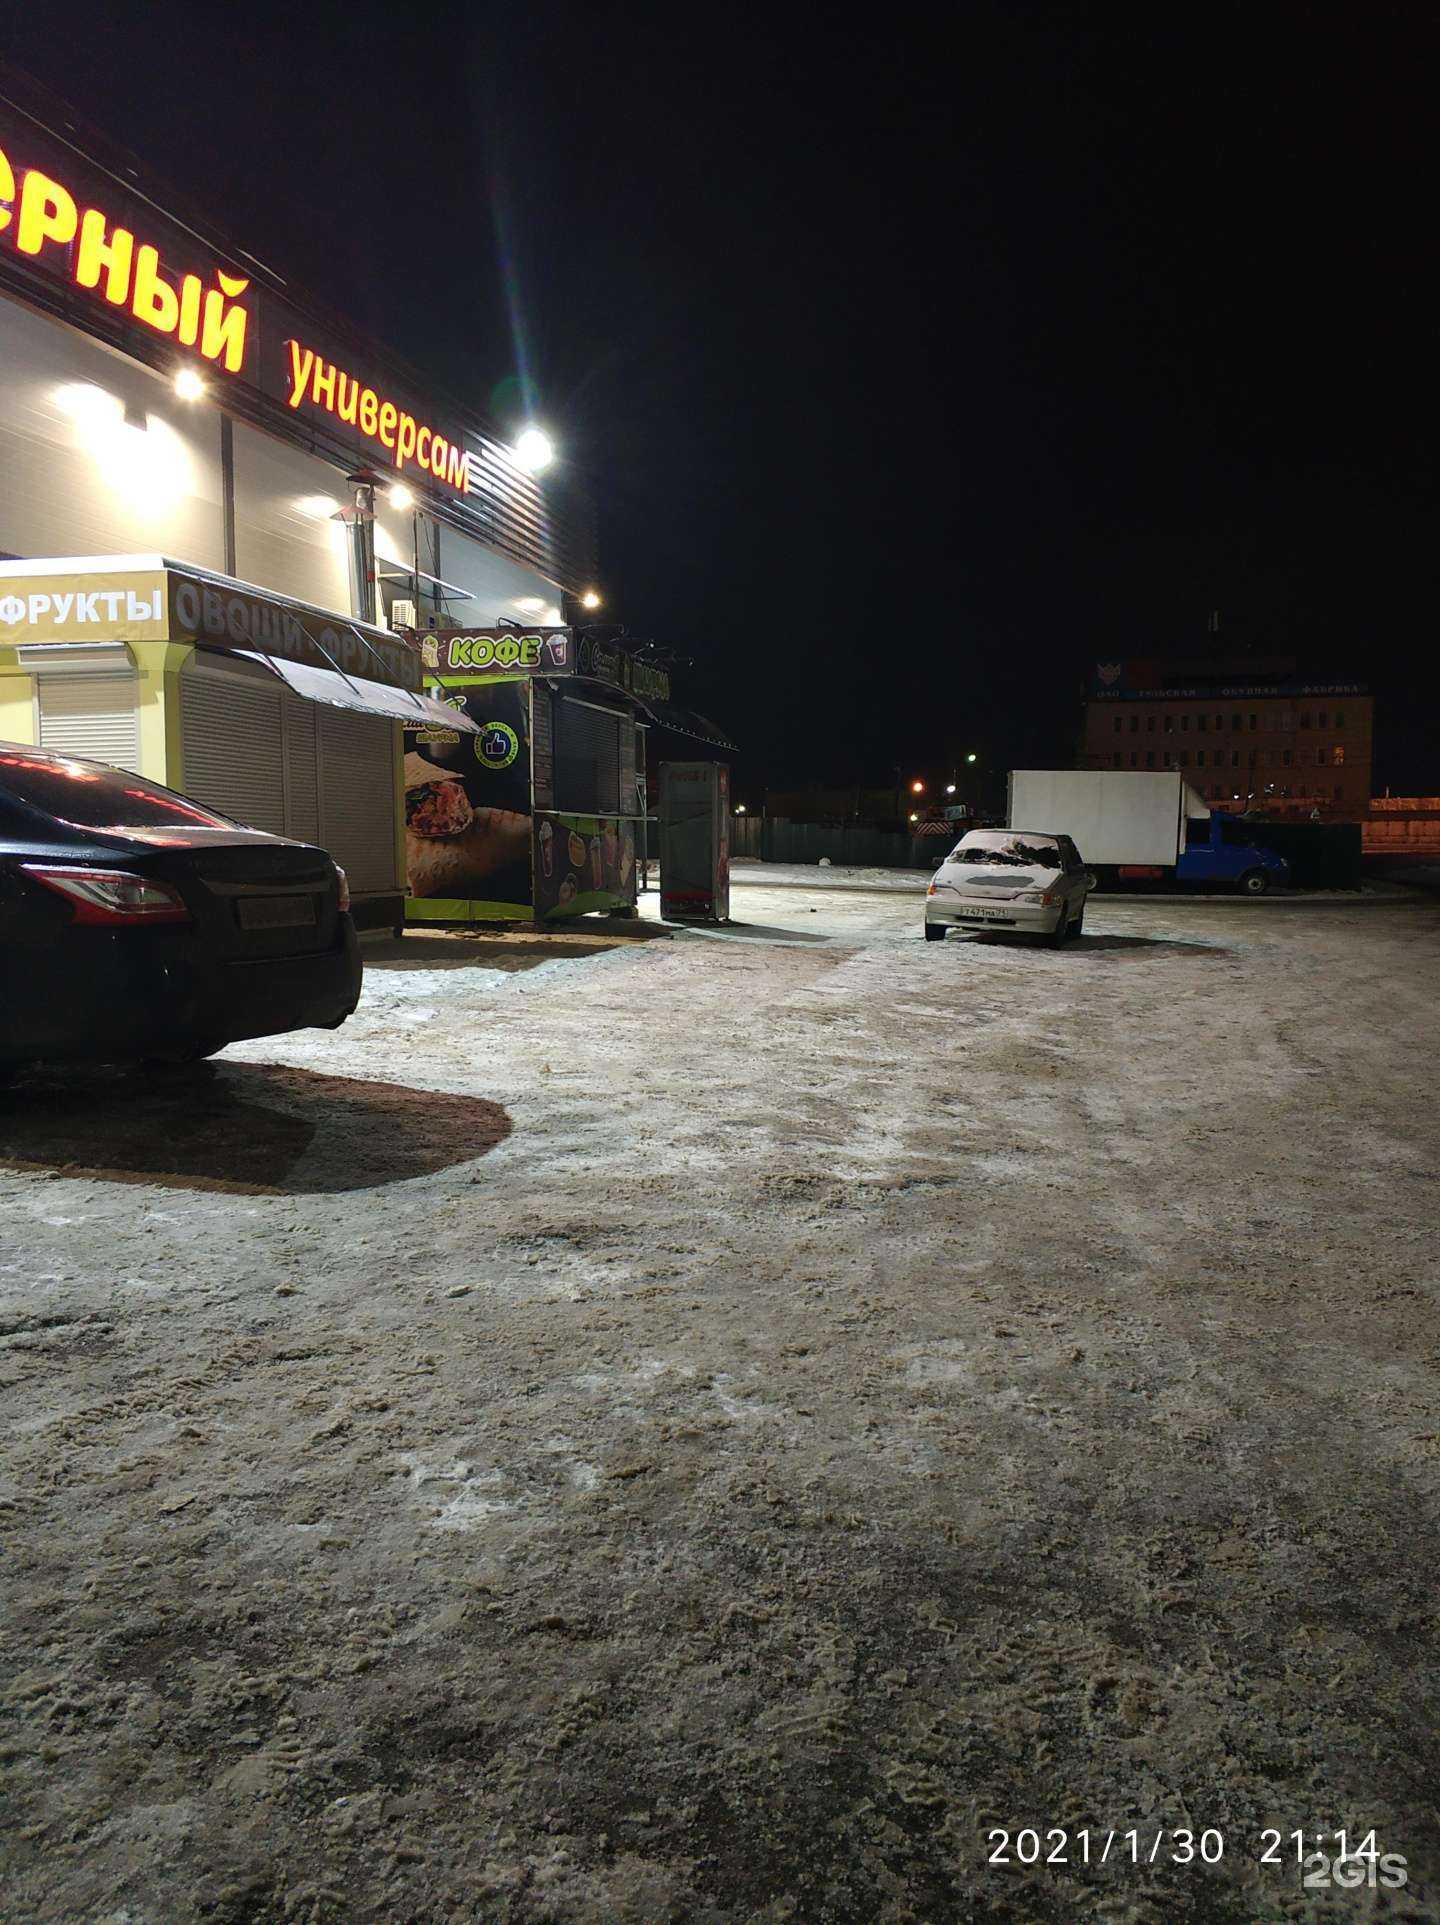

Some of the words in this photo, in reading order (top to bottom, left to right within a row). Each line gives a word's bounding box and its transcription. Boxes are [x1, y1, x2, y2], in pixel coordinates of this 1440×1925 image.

[287, 338, 472, 494] универсам
[0, 593, 162, 626] ФРУКТЫ
[175, 582, 305, 656] ОВОЩИ
[448, 634, 542, 669] КОФЕ
